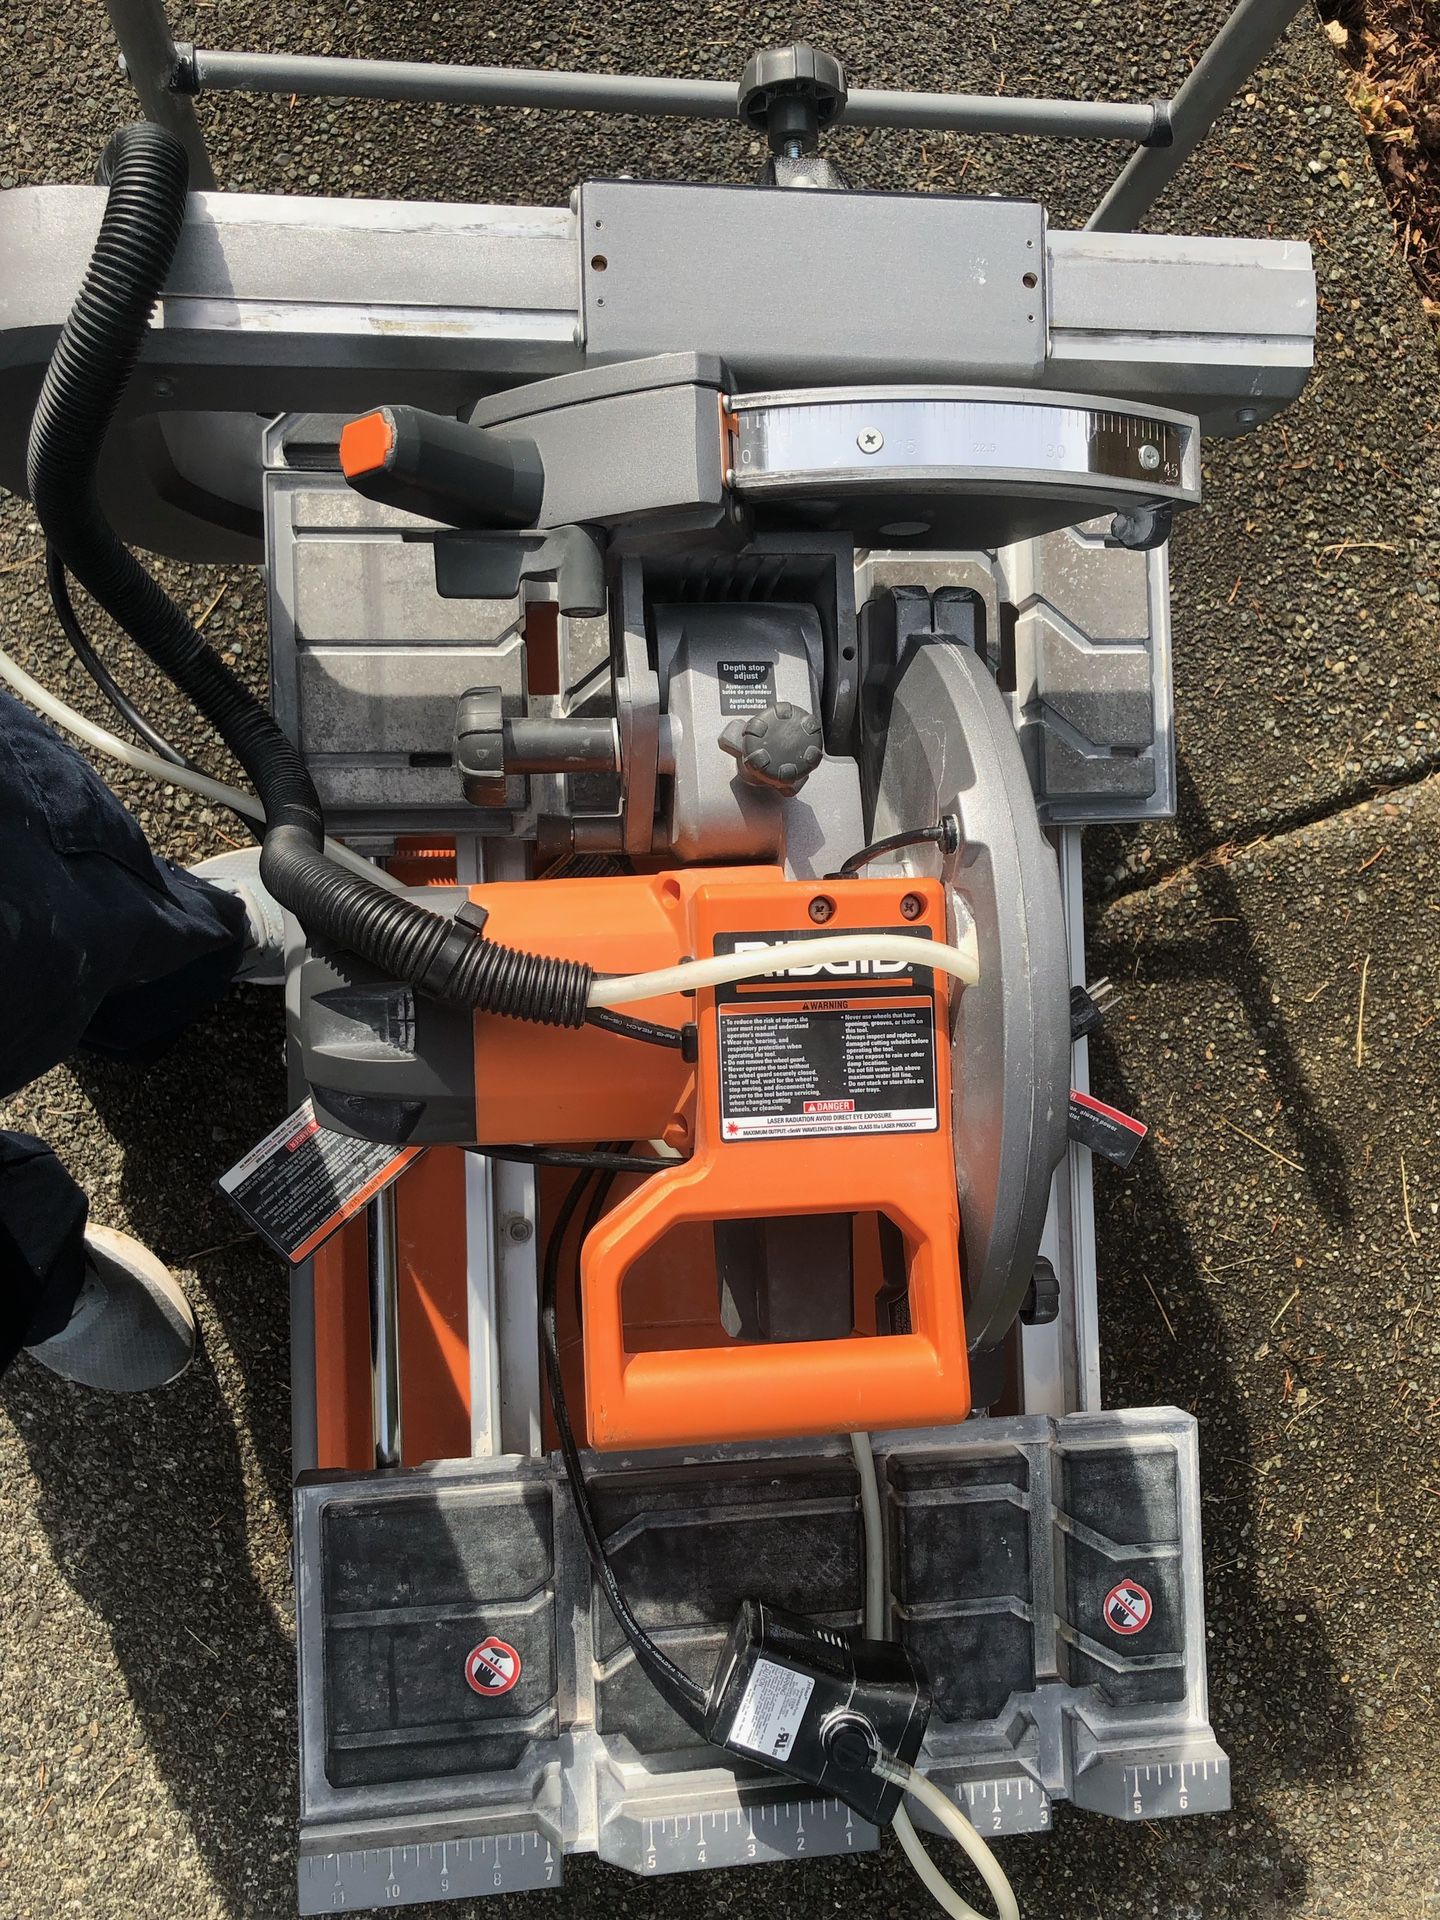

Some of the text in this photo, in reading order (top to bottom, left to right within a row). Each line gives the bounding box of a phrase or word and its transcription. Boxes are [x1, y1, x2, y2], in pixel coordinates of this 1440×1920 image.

[741, 449, 751, 464] 0
[1047, 444, 1065, 458] 30
[1164, 462, 1179, 477] 45
[723, 664, 765, 672] Depth stop
[734, 672, 758, 680] adjust
[810, 1000, 848, 1009] WARNING
[745, 1064, 766, 1072] operate
[816, 1102, 849, 1110] DANGER
[288, 1126, 312, 1148] DANGER
[1133, 1796, 1188, 1814] 5 6
[993, 1811, 1049, 1829] 2 3
[648, 1832, 852, 1869] 5 4 3 2 1
[331, 1866, 554, 1904] 11 10 9 8 7
